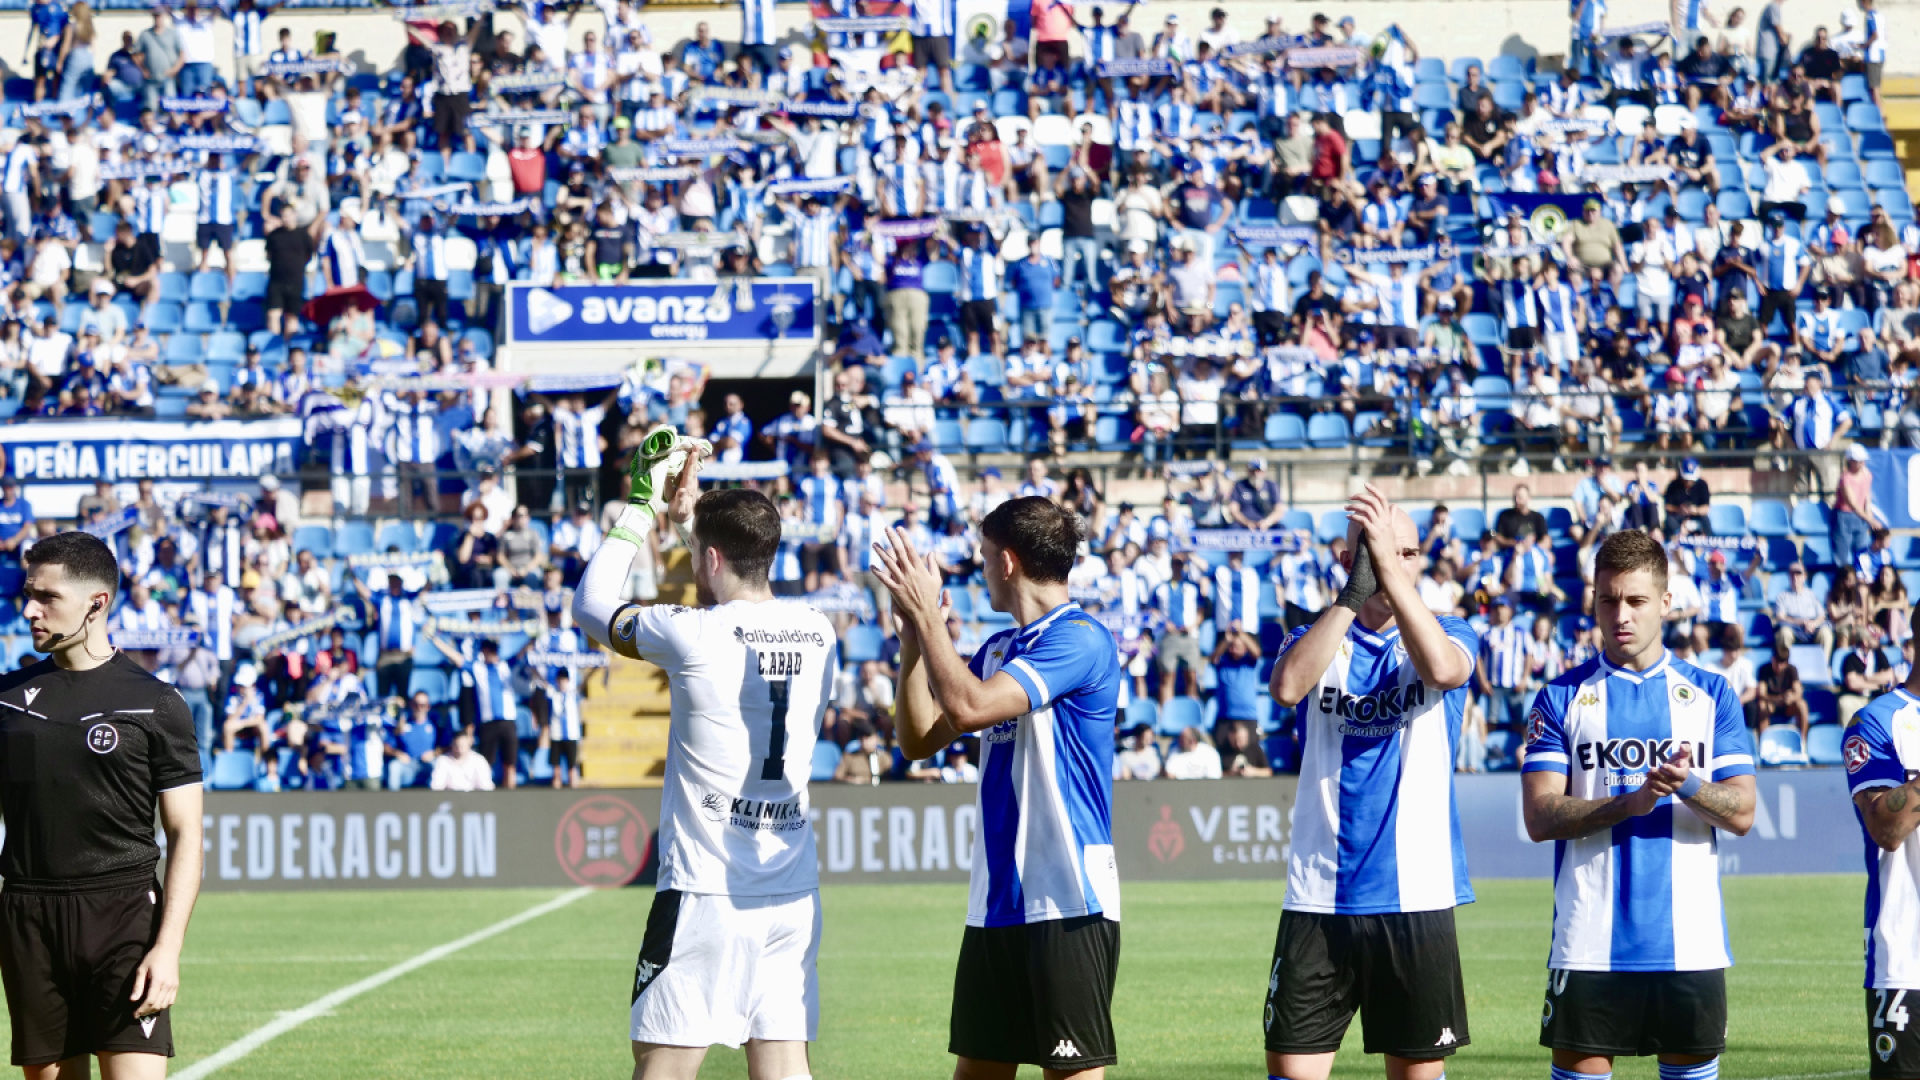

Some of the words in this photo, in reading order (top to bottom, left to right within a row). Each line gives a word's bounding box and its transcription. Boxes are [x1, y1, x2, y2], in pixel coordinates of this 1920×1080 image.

[581, 296, 731, 324] avanza
[651, 324, 708, 340] energy
[14, 441, 99, 480] PEÑA
[744, 629, 825, 648] alibuilding
[758, 651, 802, 676] C.ABAD
[1319, 679, 1426, 723] EKOKAI
[761, 680, 788, 781] 1
[1188, 805, 1296, 842] VER
[1872, 988, 1910, 1032] 24
